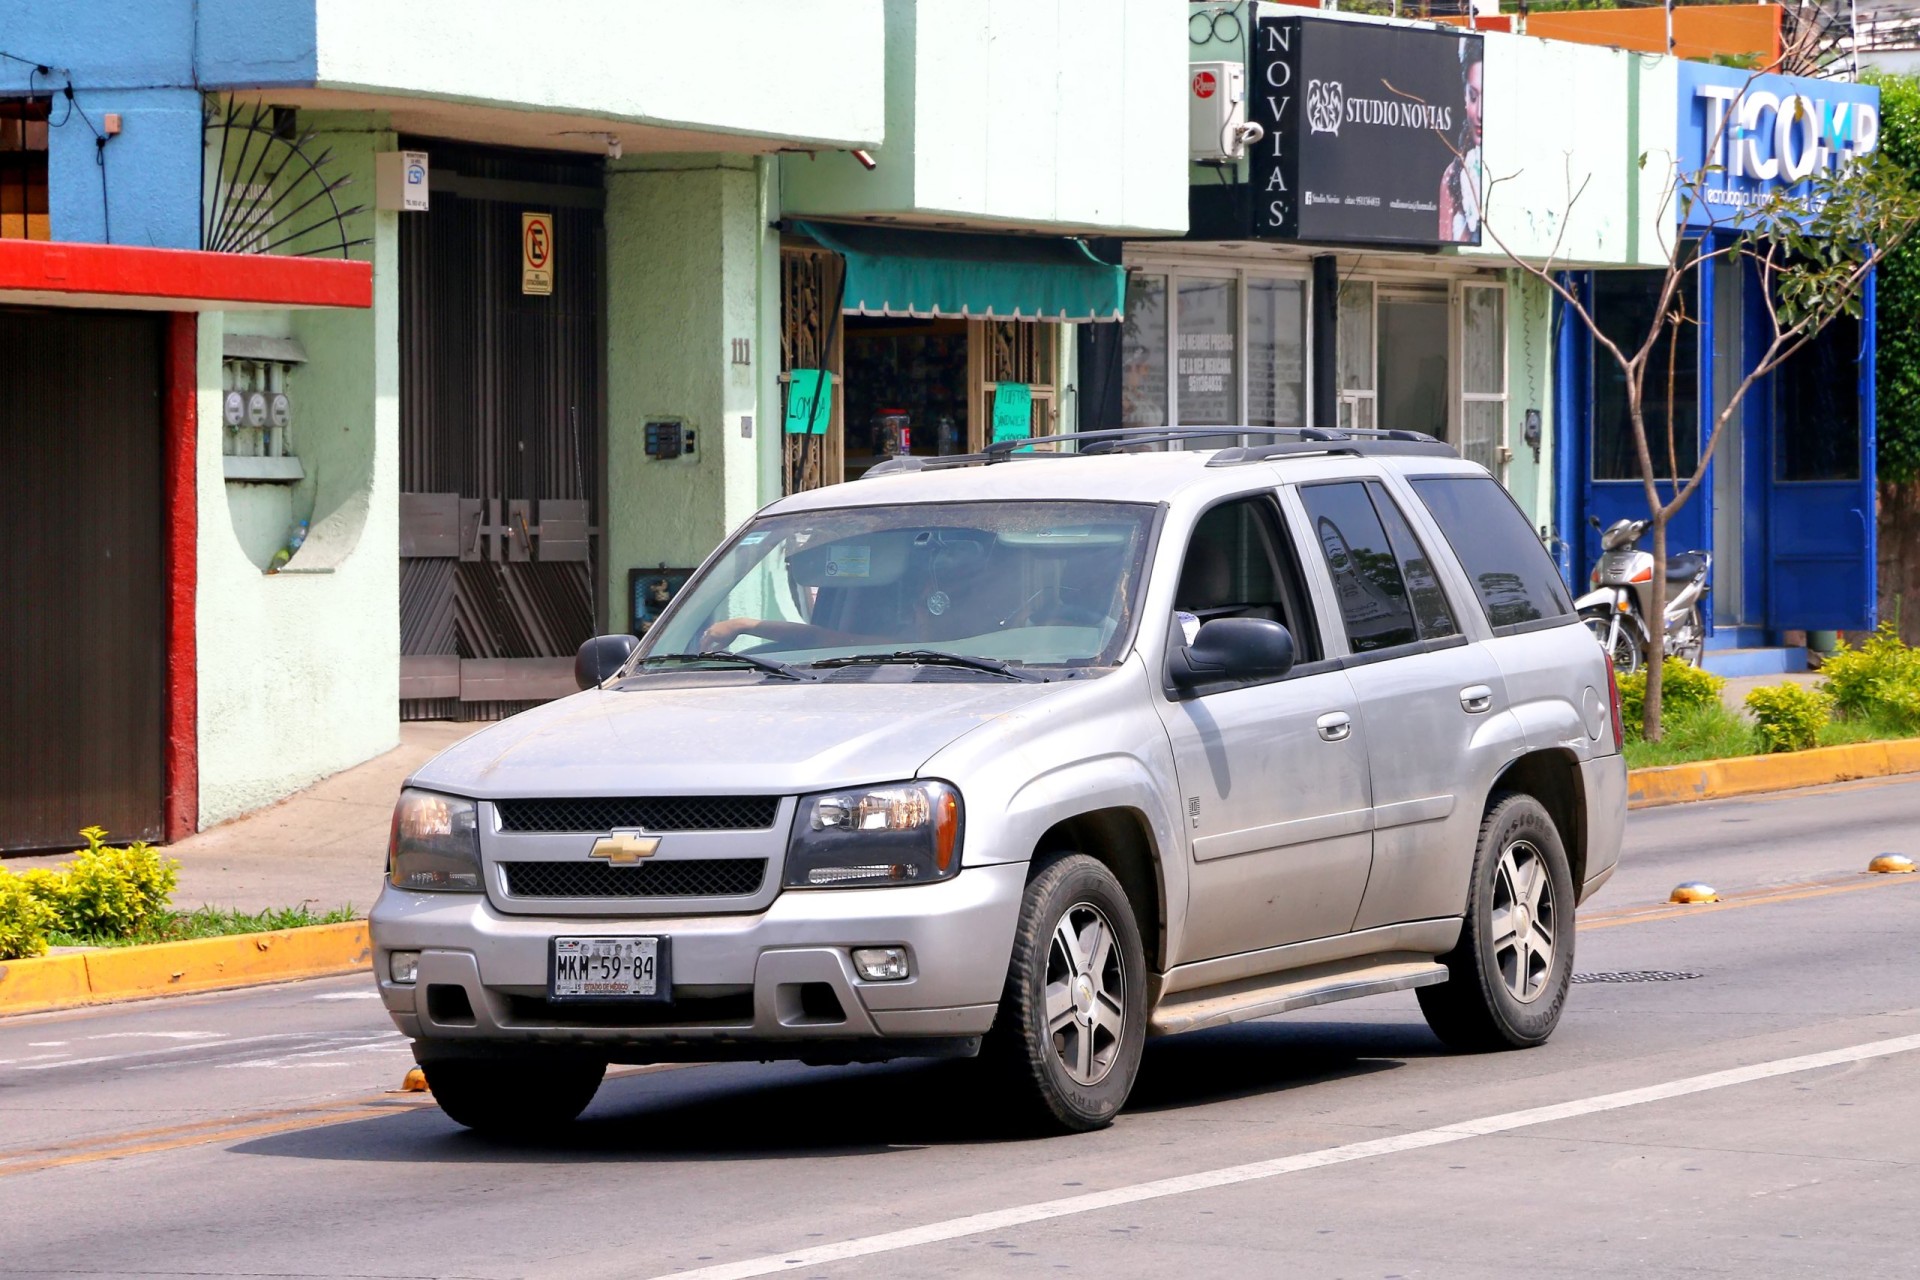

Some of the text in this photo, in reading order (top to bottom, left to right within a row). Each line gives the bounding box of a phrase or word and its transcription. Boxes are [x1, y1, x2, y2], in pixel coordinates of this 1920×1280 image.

[1265, 26, 1291, 227] NOVIAS
[1346, 97, 1452, 131] STUDIO NOVIAS
[732, 338, 750, 365] 111
[557, 955, 654, 981] MKM-59-84
